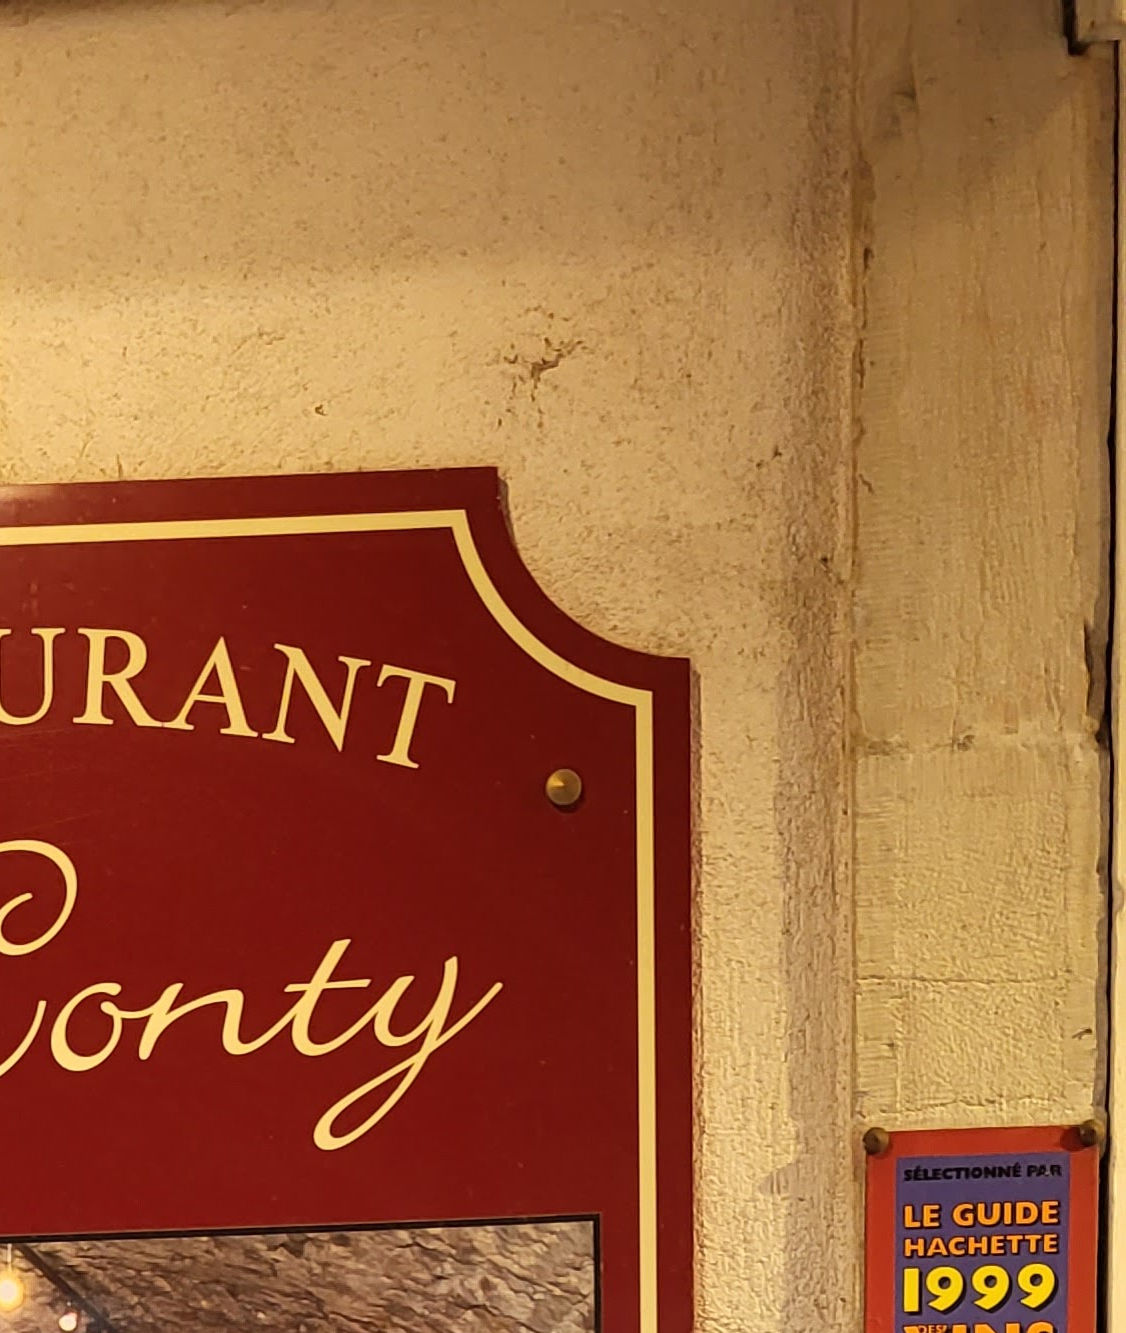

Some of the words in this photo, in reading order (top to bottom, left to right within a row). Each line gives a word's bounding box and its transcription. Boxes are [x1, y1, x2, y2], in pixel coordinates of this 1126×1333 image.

[904, 1162, 1021, 1181] SÉLECTIONNÉ
[1027, 1164, 1062, 1178] PAR
[903, 1204, 940, 1229] LE
[952, 1201, 1060, 1227] GUIDE
[904, 1233, 1059, 1257] HACHETTE
[902, 1263, 1057, 1314] 1999
